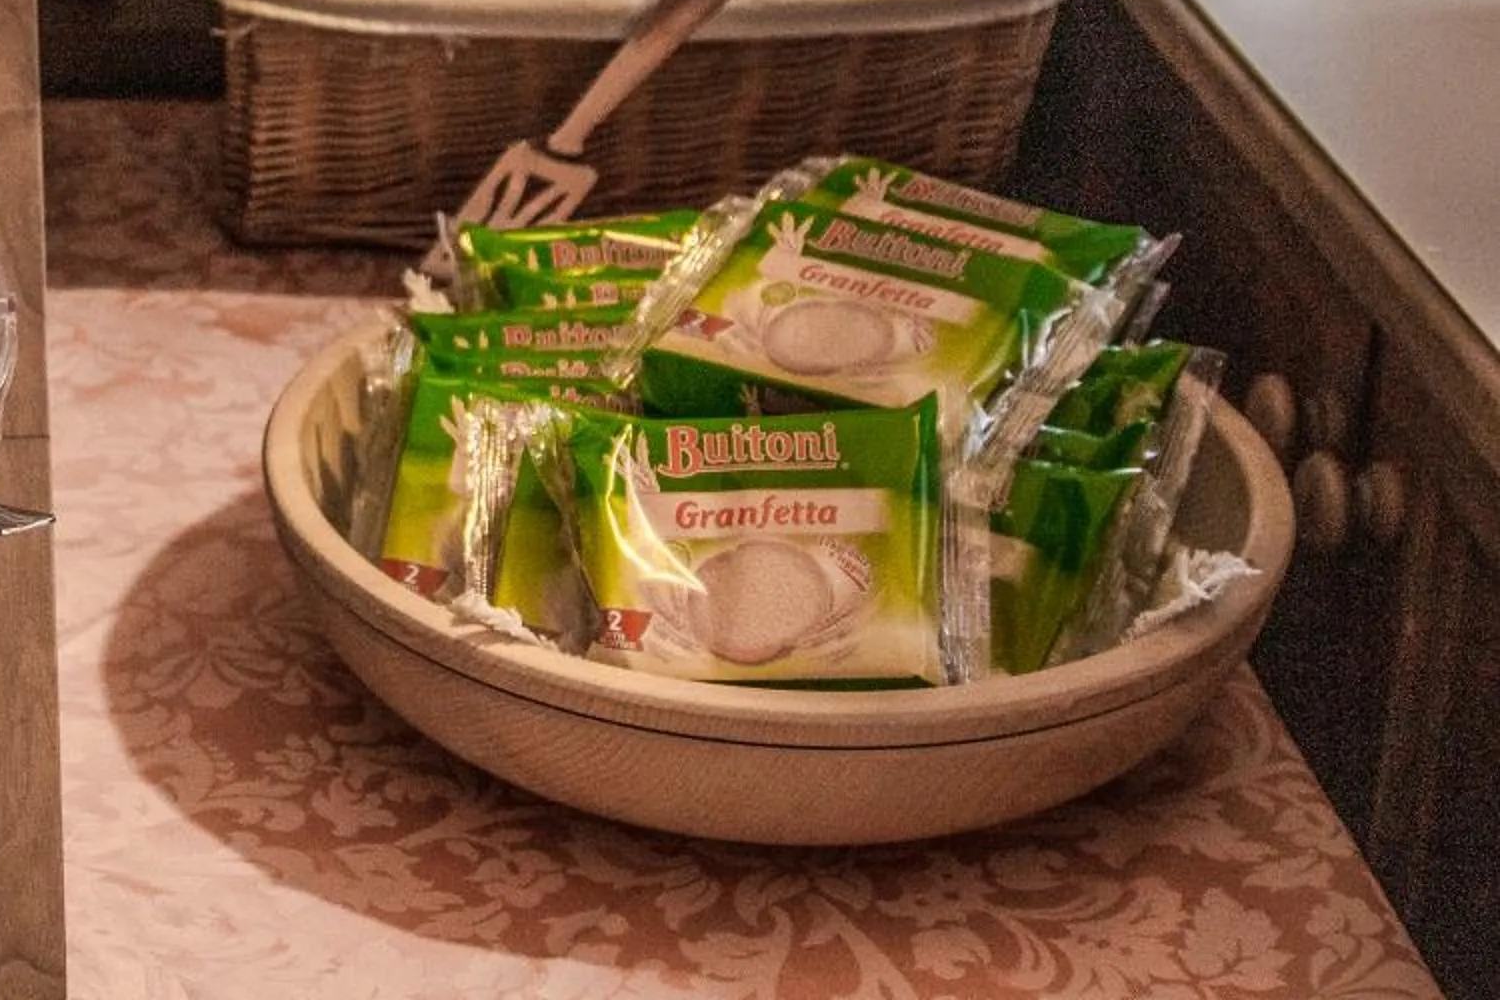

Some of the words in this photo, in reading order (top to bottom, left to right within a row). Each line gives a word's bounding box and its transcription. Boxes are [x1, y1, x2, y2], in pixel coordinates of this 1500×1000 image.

[806, 217, 971, 281] Buitoni
[799, 263, 936, 309] Granfetta
[654, 421, 841, 478] Buitoni
[674, 495, 839, 529] Granfetta
[403, 564, 420, 585] 2
[607, 610, 623, 632] 2
